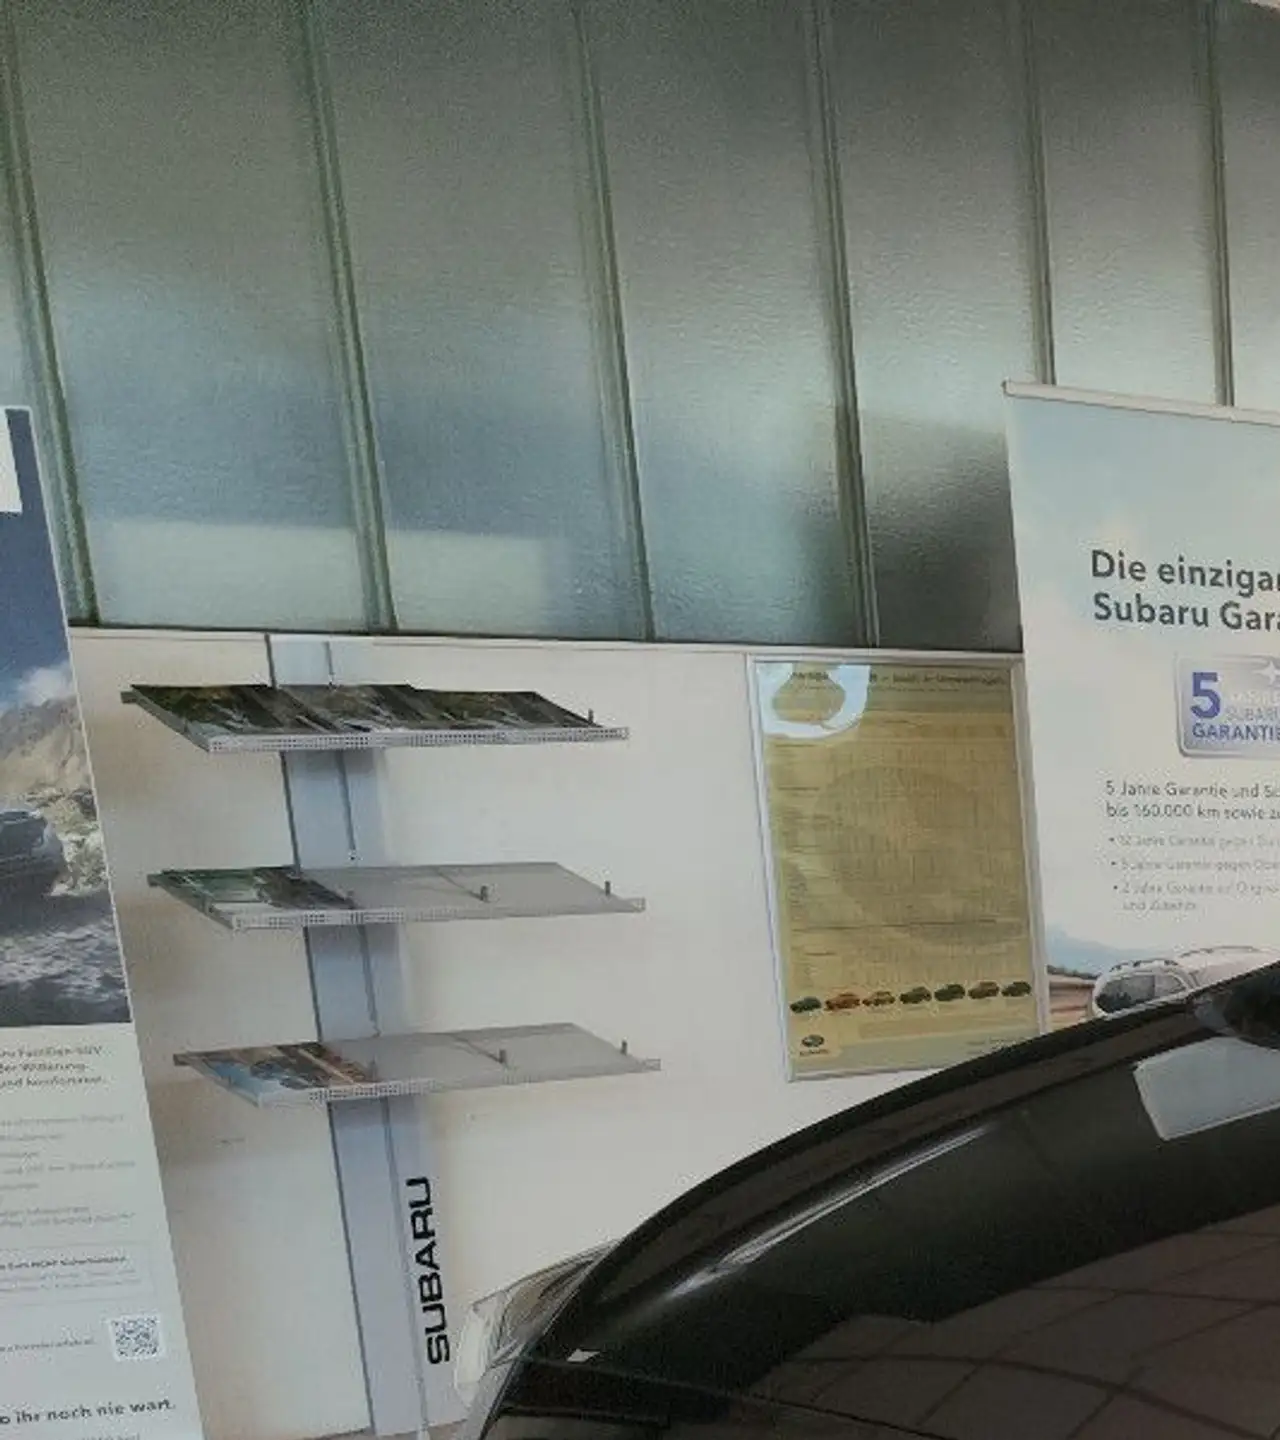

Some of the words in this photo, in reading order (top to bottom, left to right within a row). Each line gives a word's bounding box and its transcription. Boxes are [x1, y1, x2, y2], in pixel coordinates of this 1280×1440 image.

[1091, 549, 1147, 581] Die
[1094, 592, 1209, 627] Subaru
[1190, 672, 1221, 718] 5
[1106, 780, 1115, 796] 5
[1121, 781, 1160, 796] Jahre
[1165, 782, 1228, 798] Garantie
[1231, 783, 1259, 798] und
[1106, 800, 1129, 817] bis
[1134, 803, 1193, 818] 160.000
[1197, 803, 1220, 818] km
[1224, 804, 1264, 820] sowie
[406, 1177, 450, 1365] SUBARU
[16, 1410, 40, 1425] ihr
[47, 1404, 93, 1421] noch
[97, 1402, 125, 1416] nie
[130, 1399, 176, 1413] wart.
